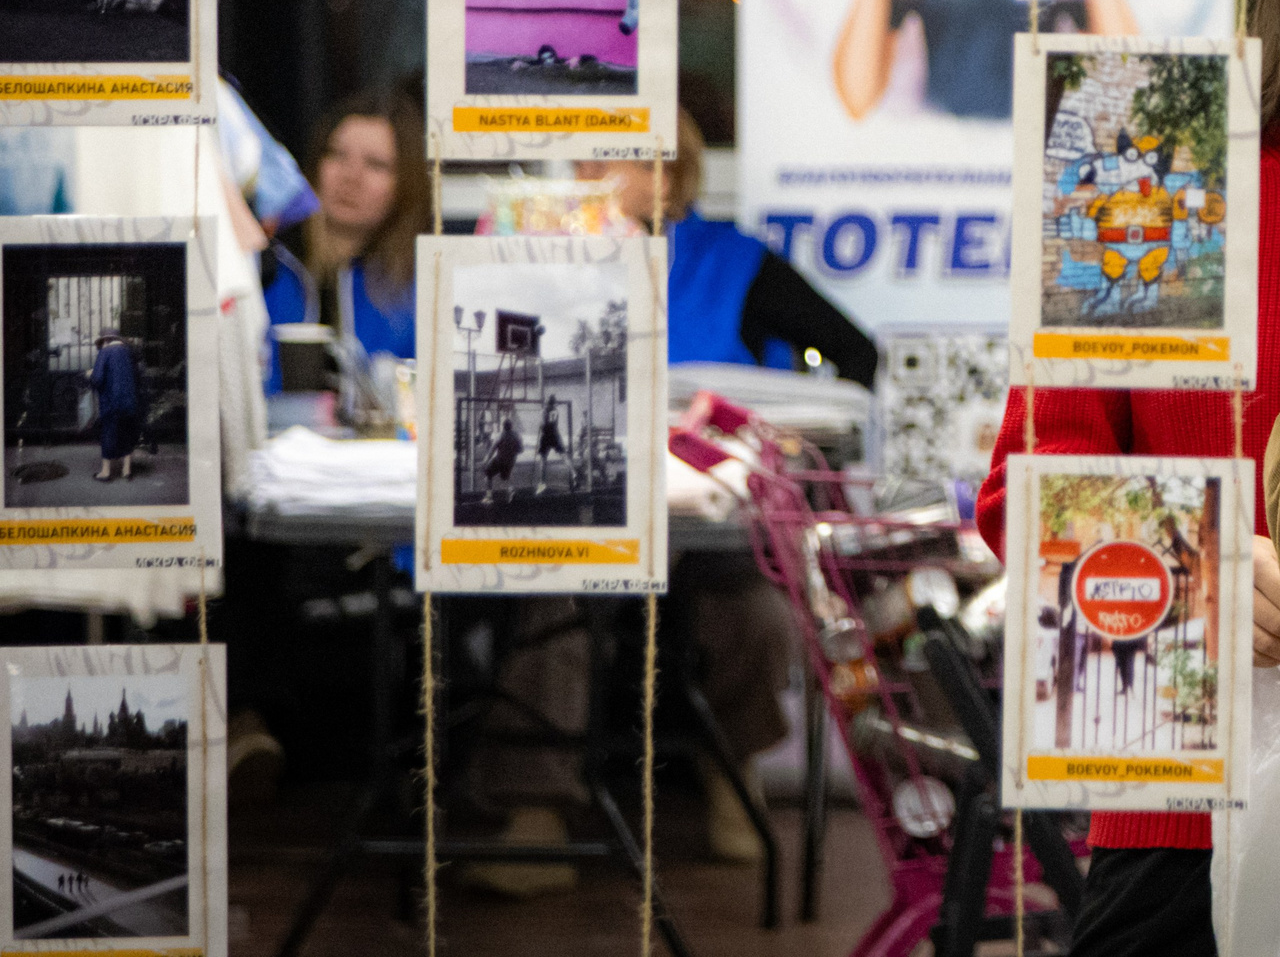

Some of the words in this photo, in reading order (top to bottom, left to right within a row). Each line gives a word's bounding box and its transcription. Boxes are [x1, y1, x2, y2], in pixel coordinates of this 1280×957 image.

[110, 82, 194, 94] АНАСТАСИЯ
[479, 114, 531, 127] NASTYA
[536, 115, 580, 127] BLANT
[585, 114, 632, 128] (DARK)
[764, 212, 1011, 273] ТОТЕ
[1073, 340, 1199, 356] BOEVOY_POKEMON
[0, 526, 111, 540] БЕЛОШАПКИНА
[114, 524, 198, 537] АНАСТАСИЯ
[1067, 763, 1193, 778] BOEVOY_POKEMON
